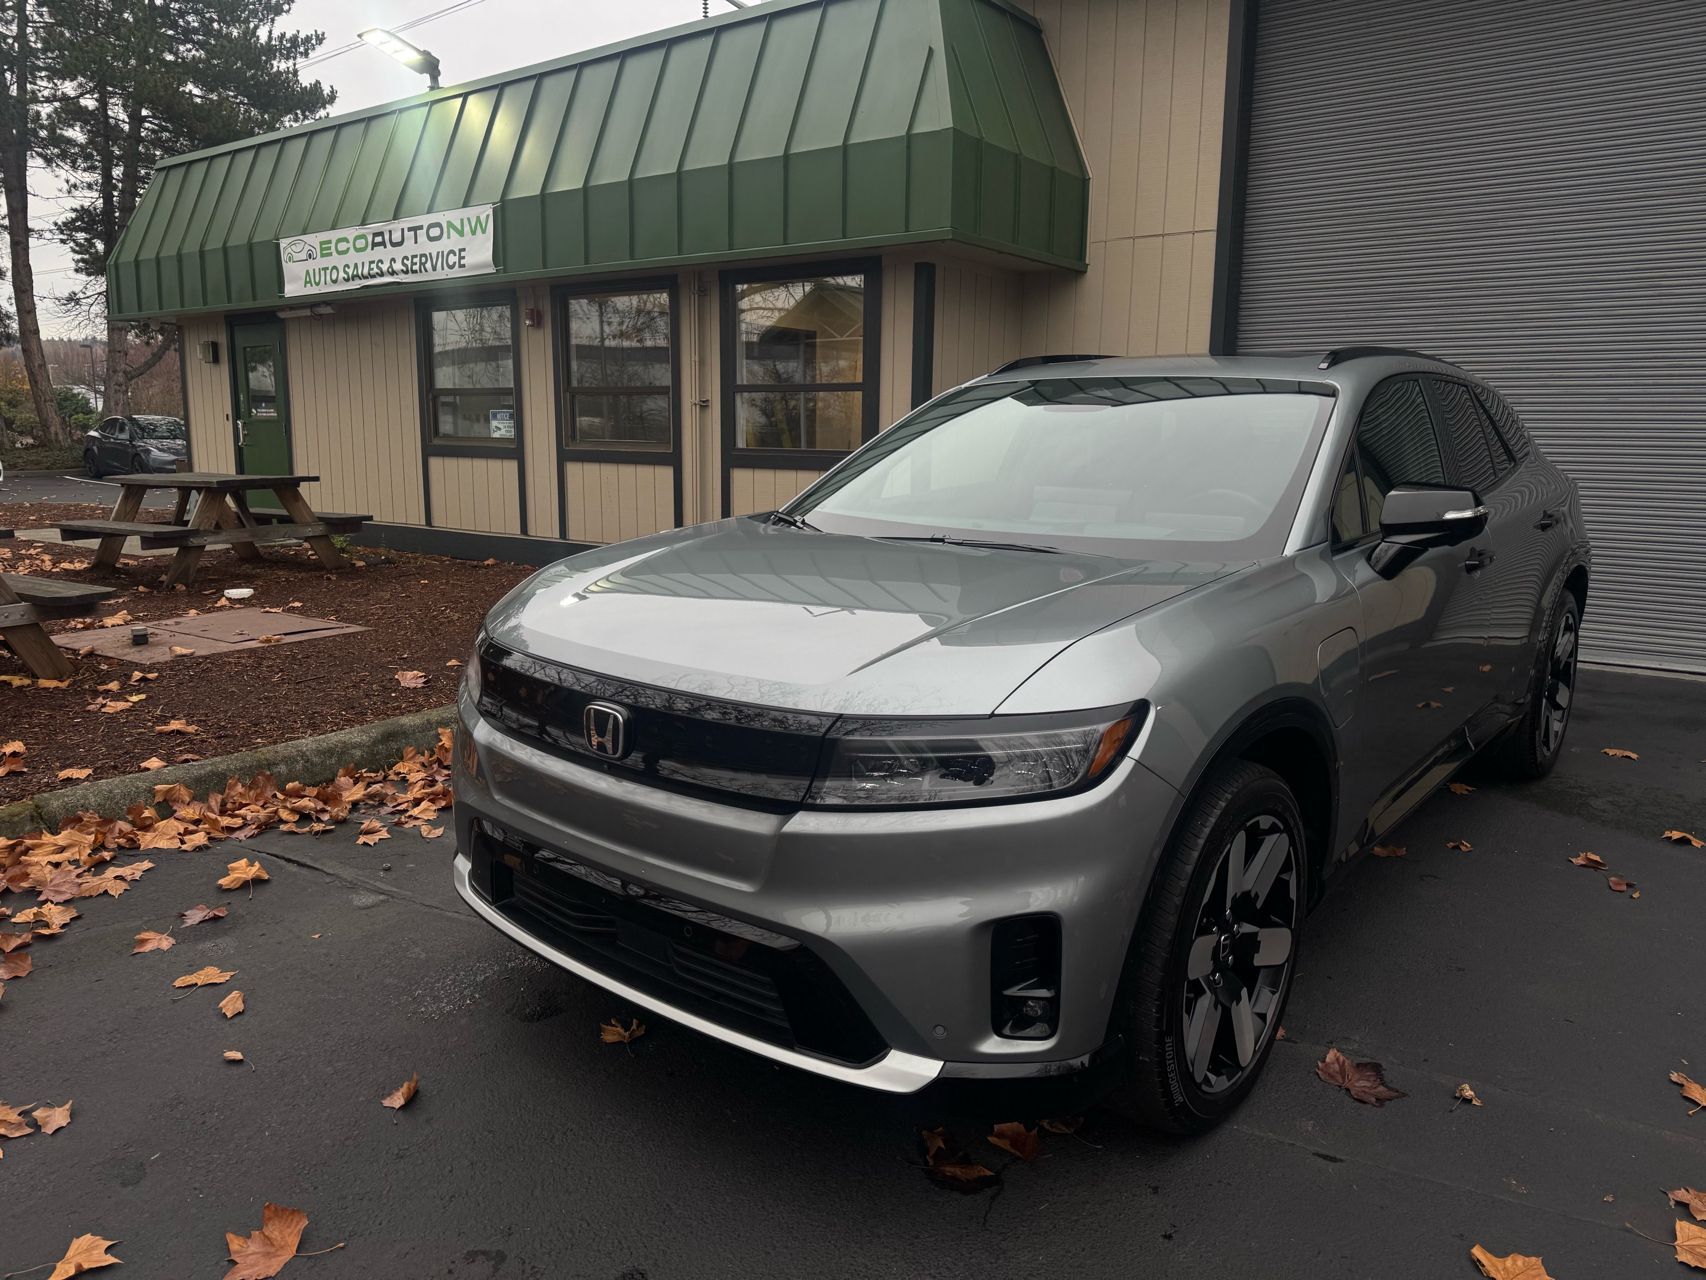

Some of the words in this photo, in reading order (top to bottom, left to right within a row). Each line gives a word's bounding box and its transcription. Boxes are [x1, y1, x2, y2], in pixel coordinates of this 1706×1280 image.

[318, 213, 490, 259] ECOAUTONW
[303, 264, 340, 289] AUTO
[342, 258, 385, 282] SALES
[387, 257, 399, 276] &
[400, 247, 467, 275] SERVICE
